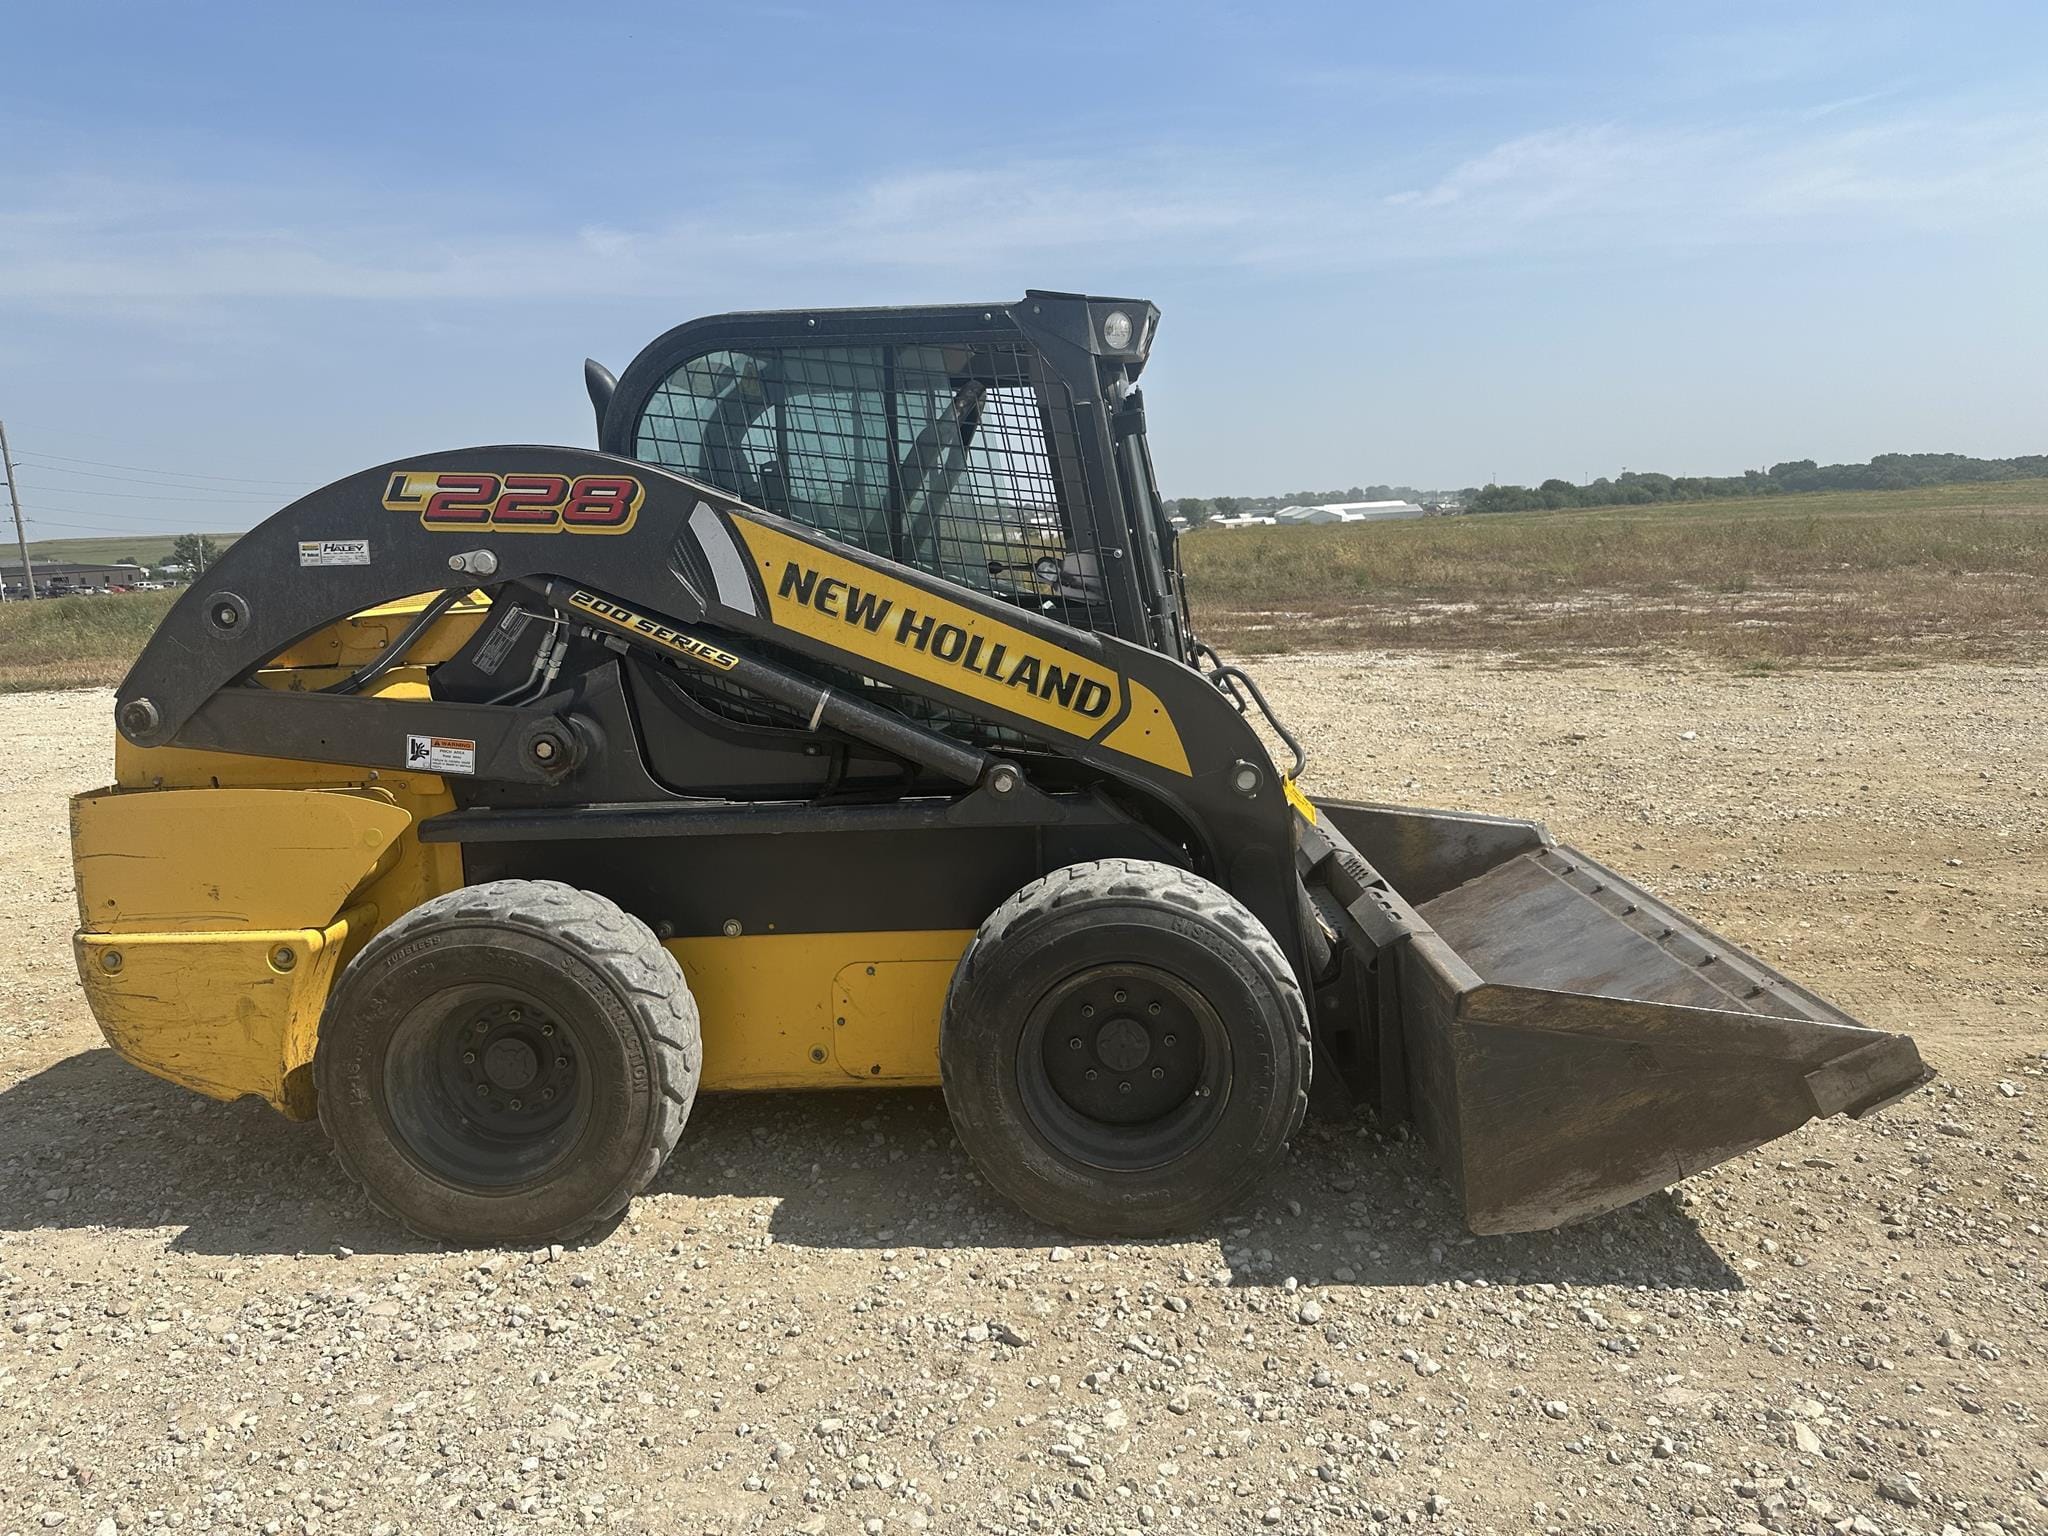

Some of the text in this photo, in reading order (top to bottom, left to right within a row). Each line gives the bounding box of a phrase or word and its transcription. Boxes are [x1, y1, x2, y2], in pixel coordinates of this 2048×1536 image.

[384, 473, 642, 530] L228
[324, 543, 364, 552] HALEY
[571, 592, 737, 667] 200 SERIES
[777, 561, 1112, 720] NEW HOLLAND
[560, 956, 648, 1095] SUPERTRACTION
